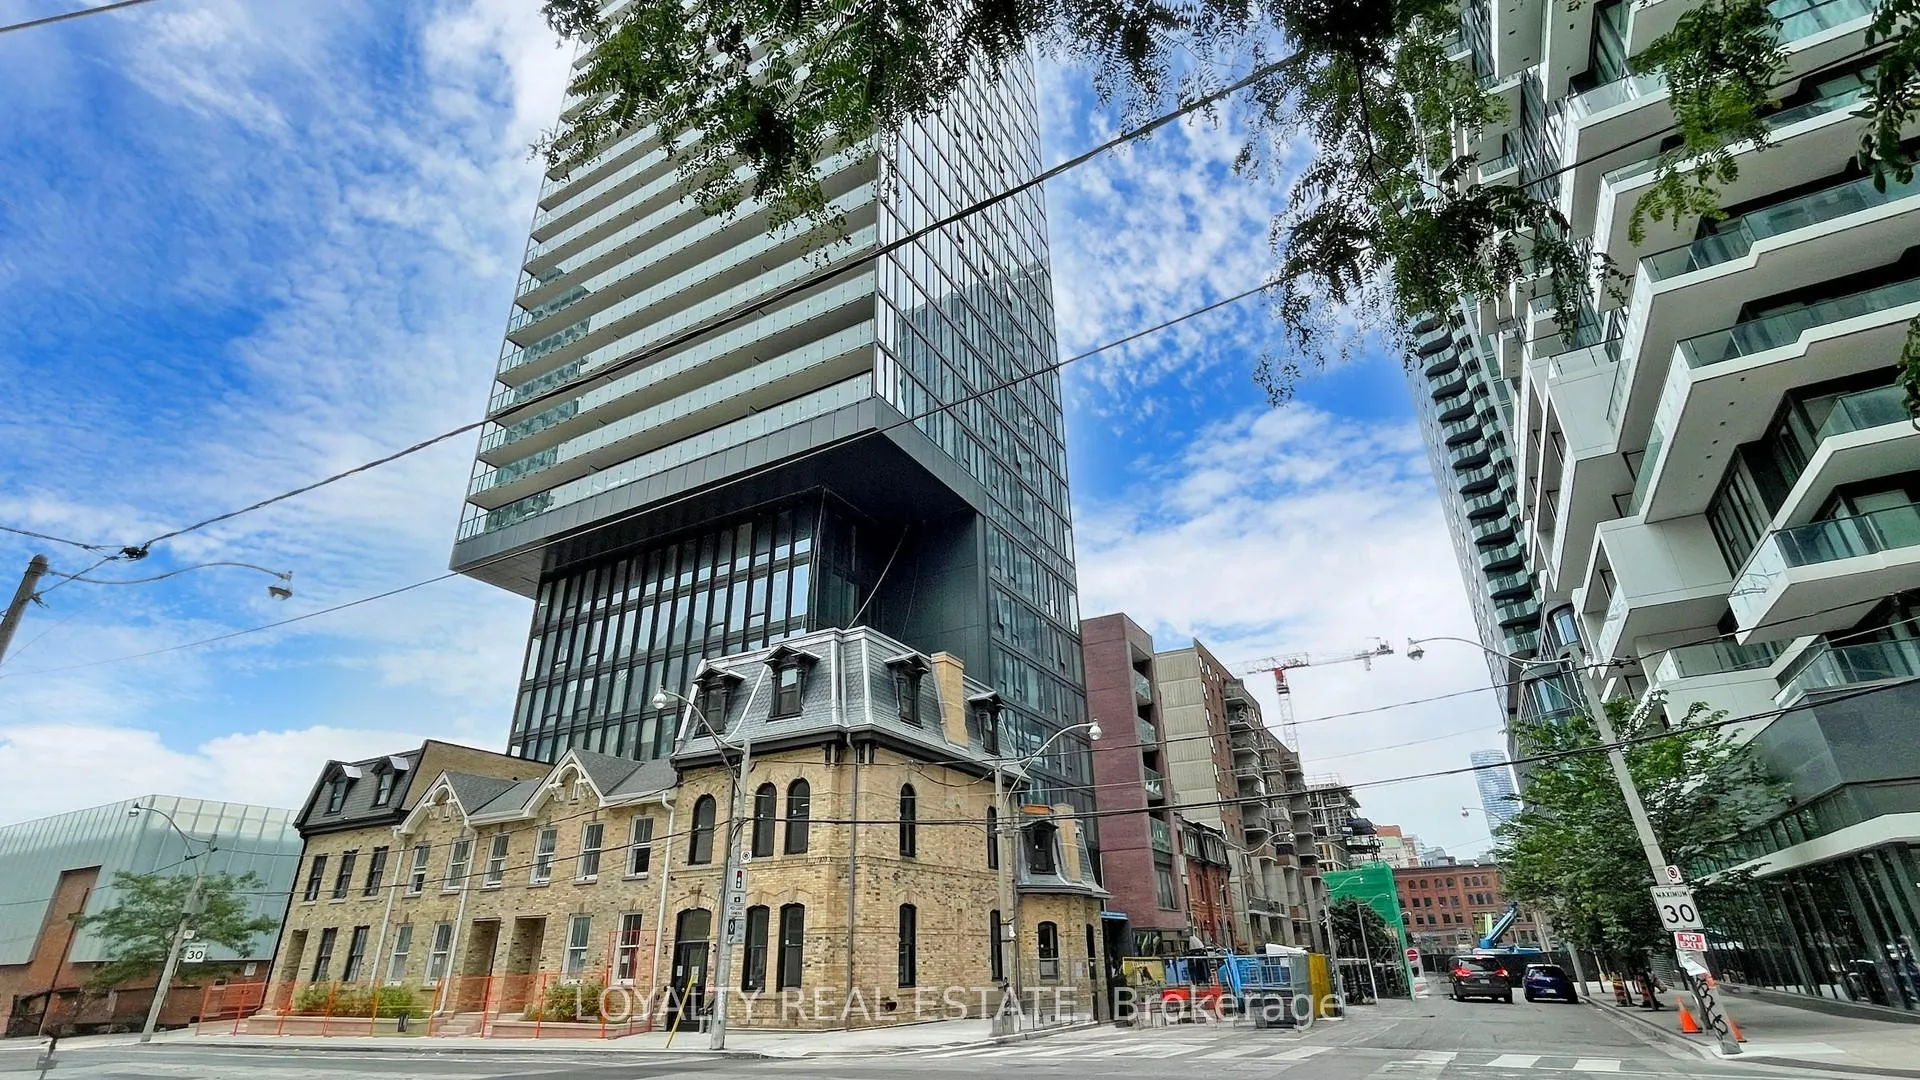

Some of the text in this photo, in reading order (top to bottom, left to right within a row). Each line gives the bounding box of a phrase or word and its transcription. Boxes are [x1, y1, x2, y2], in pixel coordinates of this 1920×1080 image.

[1663, 904, 1695, 923] 30
[1680, 941, 1703, 949] EXIT
[187, 950, 203, 960] 30
